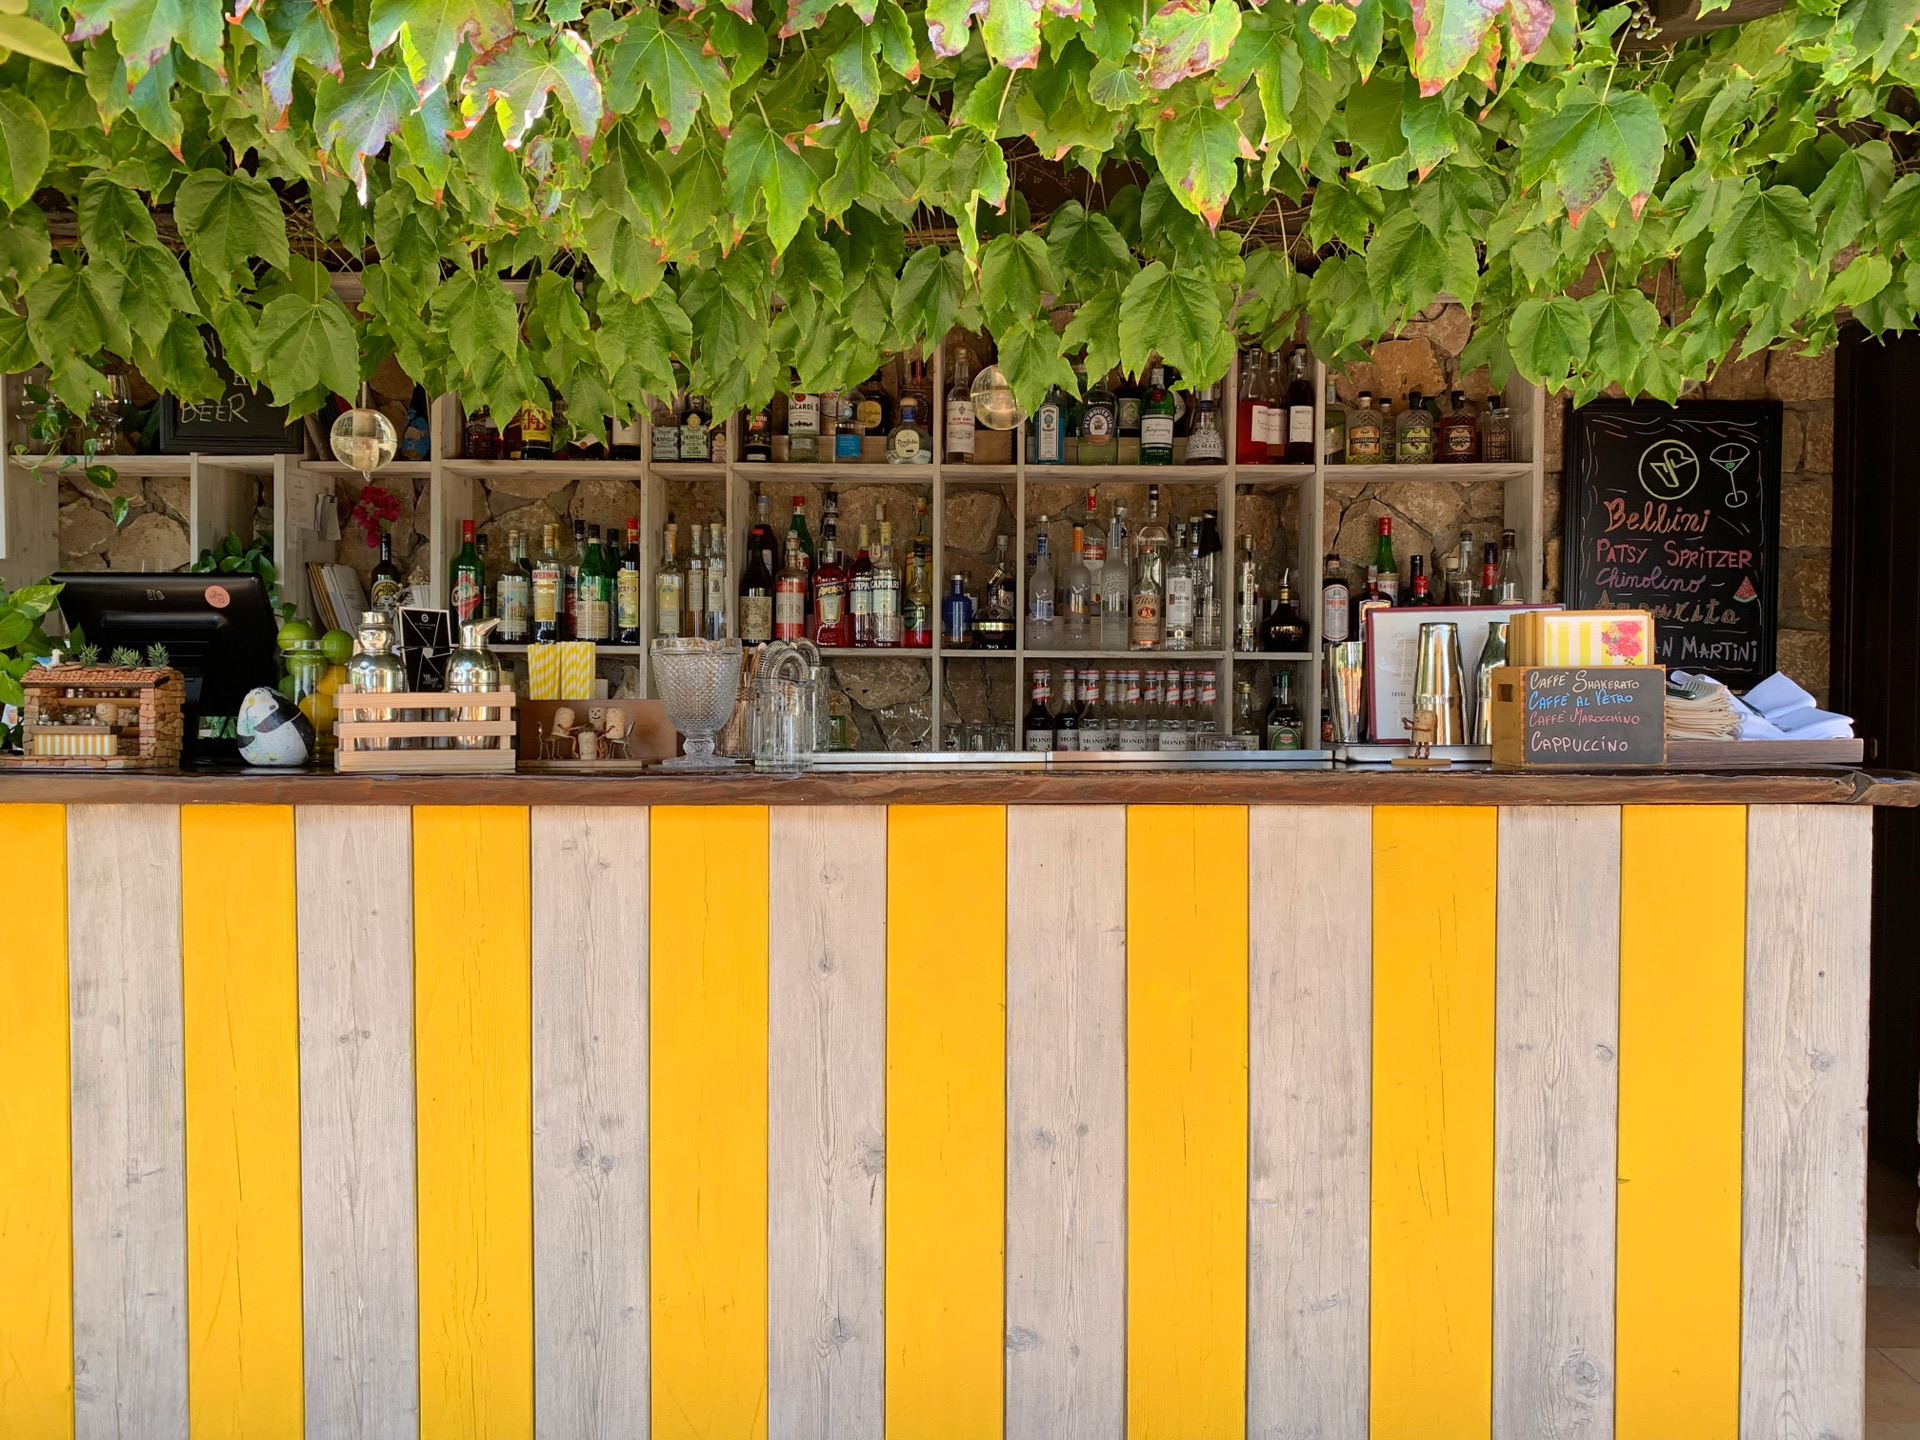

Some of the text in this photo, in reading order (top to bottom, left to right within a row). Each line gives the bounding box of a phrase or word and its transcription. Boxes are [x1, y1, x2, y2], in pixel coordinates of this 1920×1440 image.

[1084, 409, 1109, 428] PLYMOUTH
[1603, 498, 1711, 533] Bellini
[1597, 538, 1648, 564] PATSY
[819, 586, 843, 596] APEROL
[870, 580, 900, 589] CAMPARI
[1135, 596, 1159, 605] Tito's
[1572, 670, 1640, 693] SHAKERATO
[1576, 695, 1591, 707] AL
